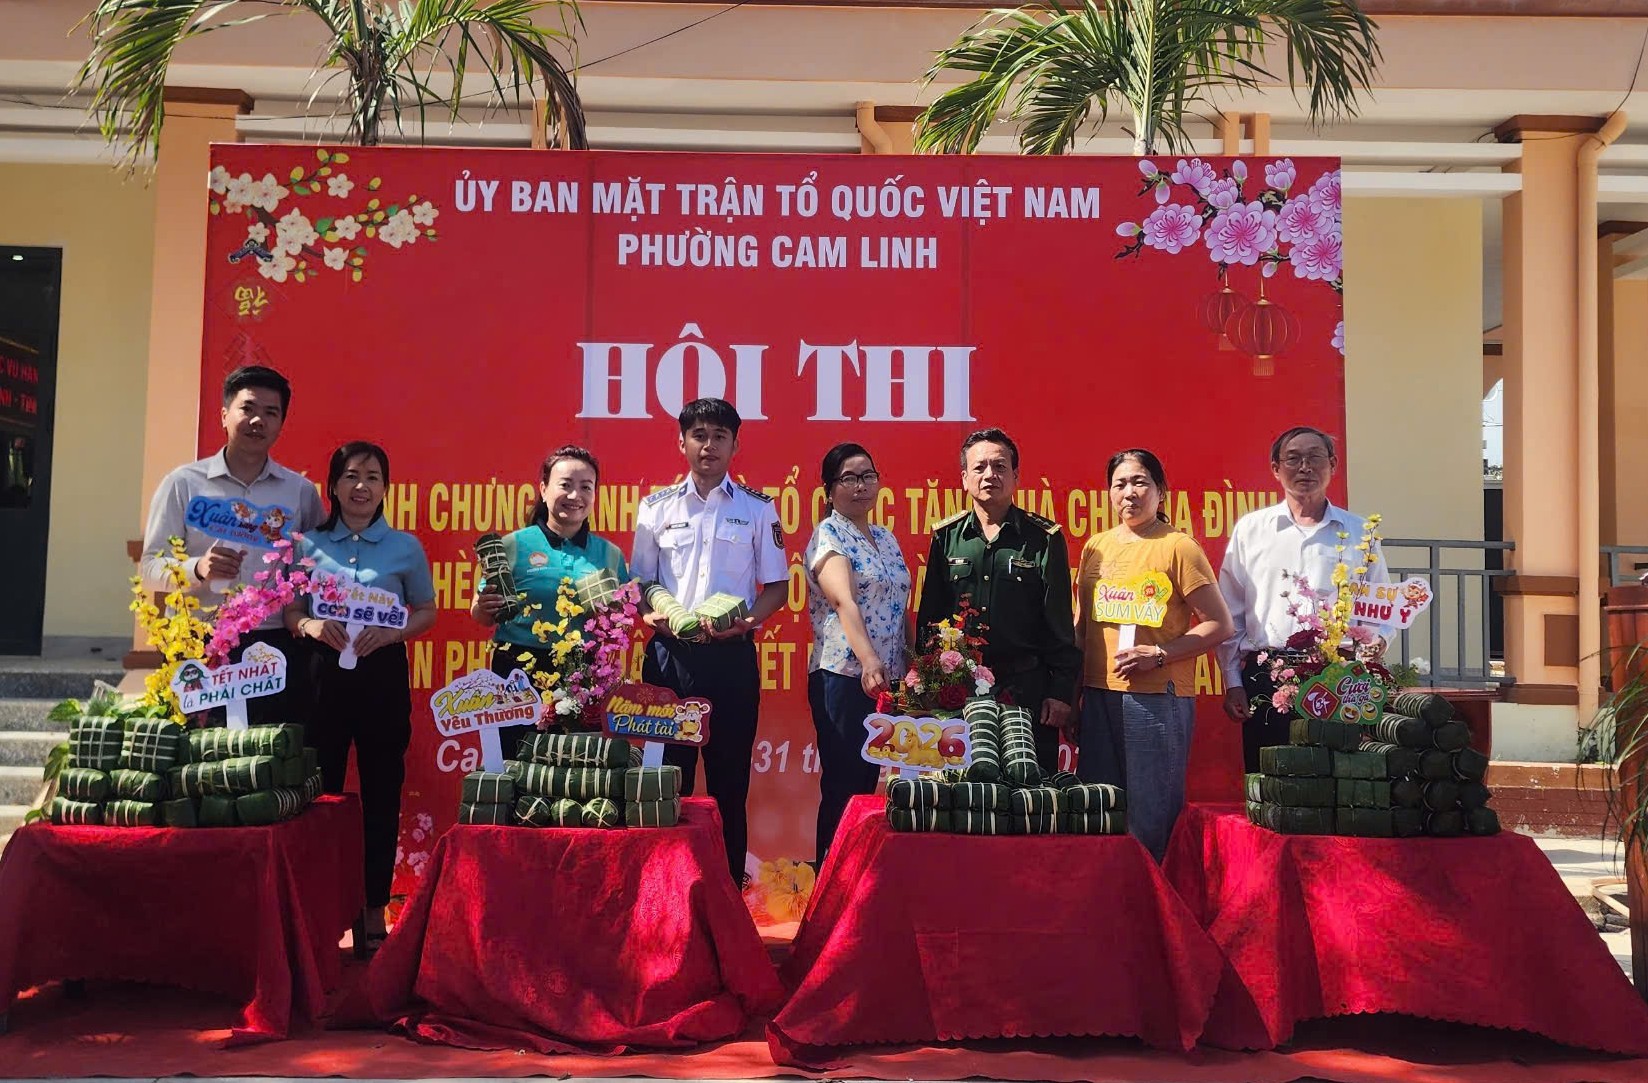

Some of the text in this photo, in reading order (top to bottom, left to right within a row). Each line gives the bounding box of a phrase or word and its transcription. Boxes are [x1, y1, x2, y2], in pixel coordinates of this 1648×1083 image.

[455, 170, 1100, 225] ỦY BAN MẶT TRẬN TỔ QUỐC VIỆT NAM
[618, 227, 937, 268] PHƯỜNG CAM LINH
[798, 338, 977, 422] THI
[1098, 584, 1135, 602] Xuân
[353, 606, 375, 622] sẽ
[1096, 601, 1130, 618] SUM
[1354, 601, 1394, 621] NHƯ
[212, 658, 278, 686] TẾT NHẤT
[199, 684, 235, 706] PHẢI
[240, 675, 283, 697] CHẤT
[434, 688, 496, 718] Xuân
[441, 705, 535, 732] Yêu Thương
[606, 695, 679, 719] Năm mới
[612, 713, 675, 736] Phát tài
[867, 718, 966, 760] 2026
[437, 740, 484, 773] Ca
